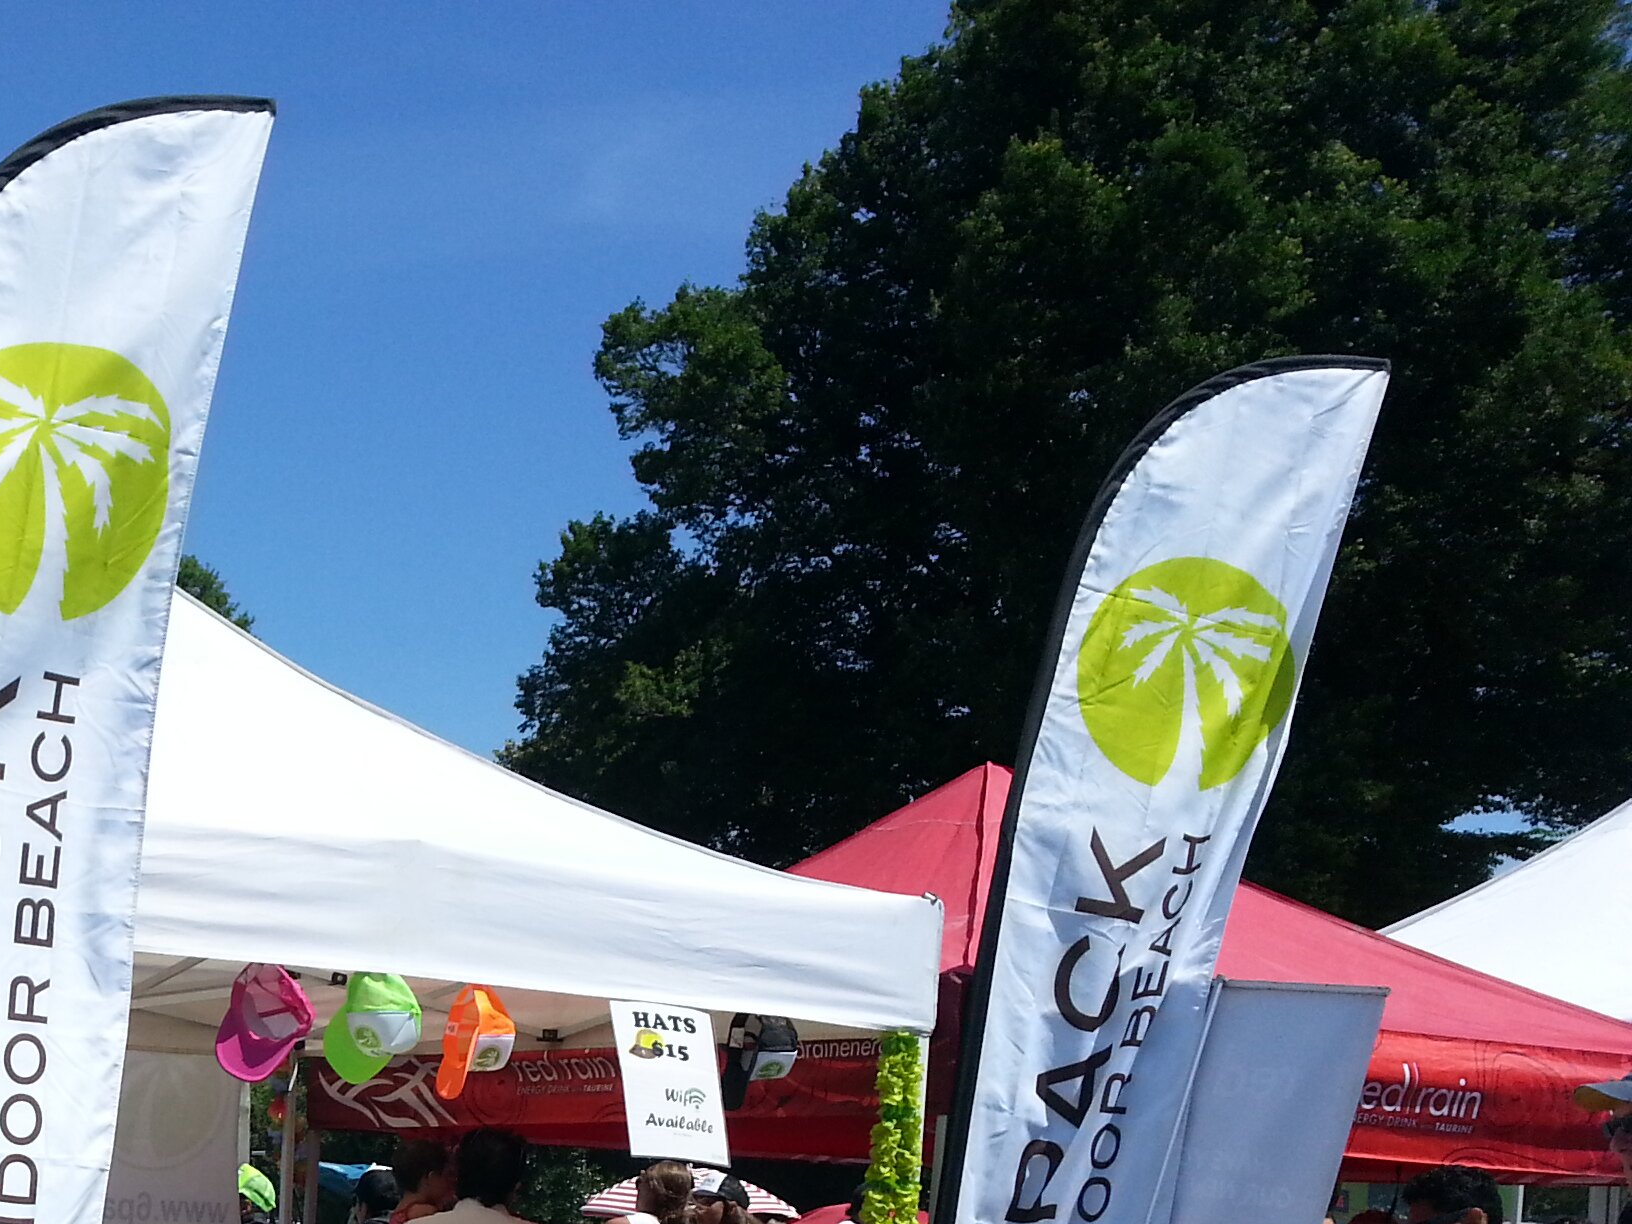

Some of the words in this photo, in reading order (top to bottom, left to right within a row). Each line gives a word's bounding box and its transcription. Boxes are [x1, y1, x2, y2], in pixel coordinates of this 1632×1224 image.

[13, 670, 80, 947] BEACH
[1120, 833, 1212, 1048] BEACH
[632, 1011, 697, 1034] HATS
[511, 1050, 558, 1082] red
[559, 1048, 616, 1080] rain
[652, 1040, 690, 1062] $15
[1414, 1078, 1483, 1120] rain
[645, 1113, 714, 1134] Available
[1355, 1112, 1385, 1125] ERGY
